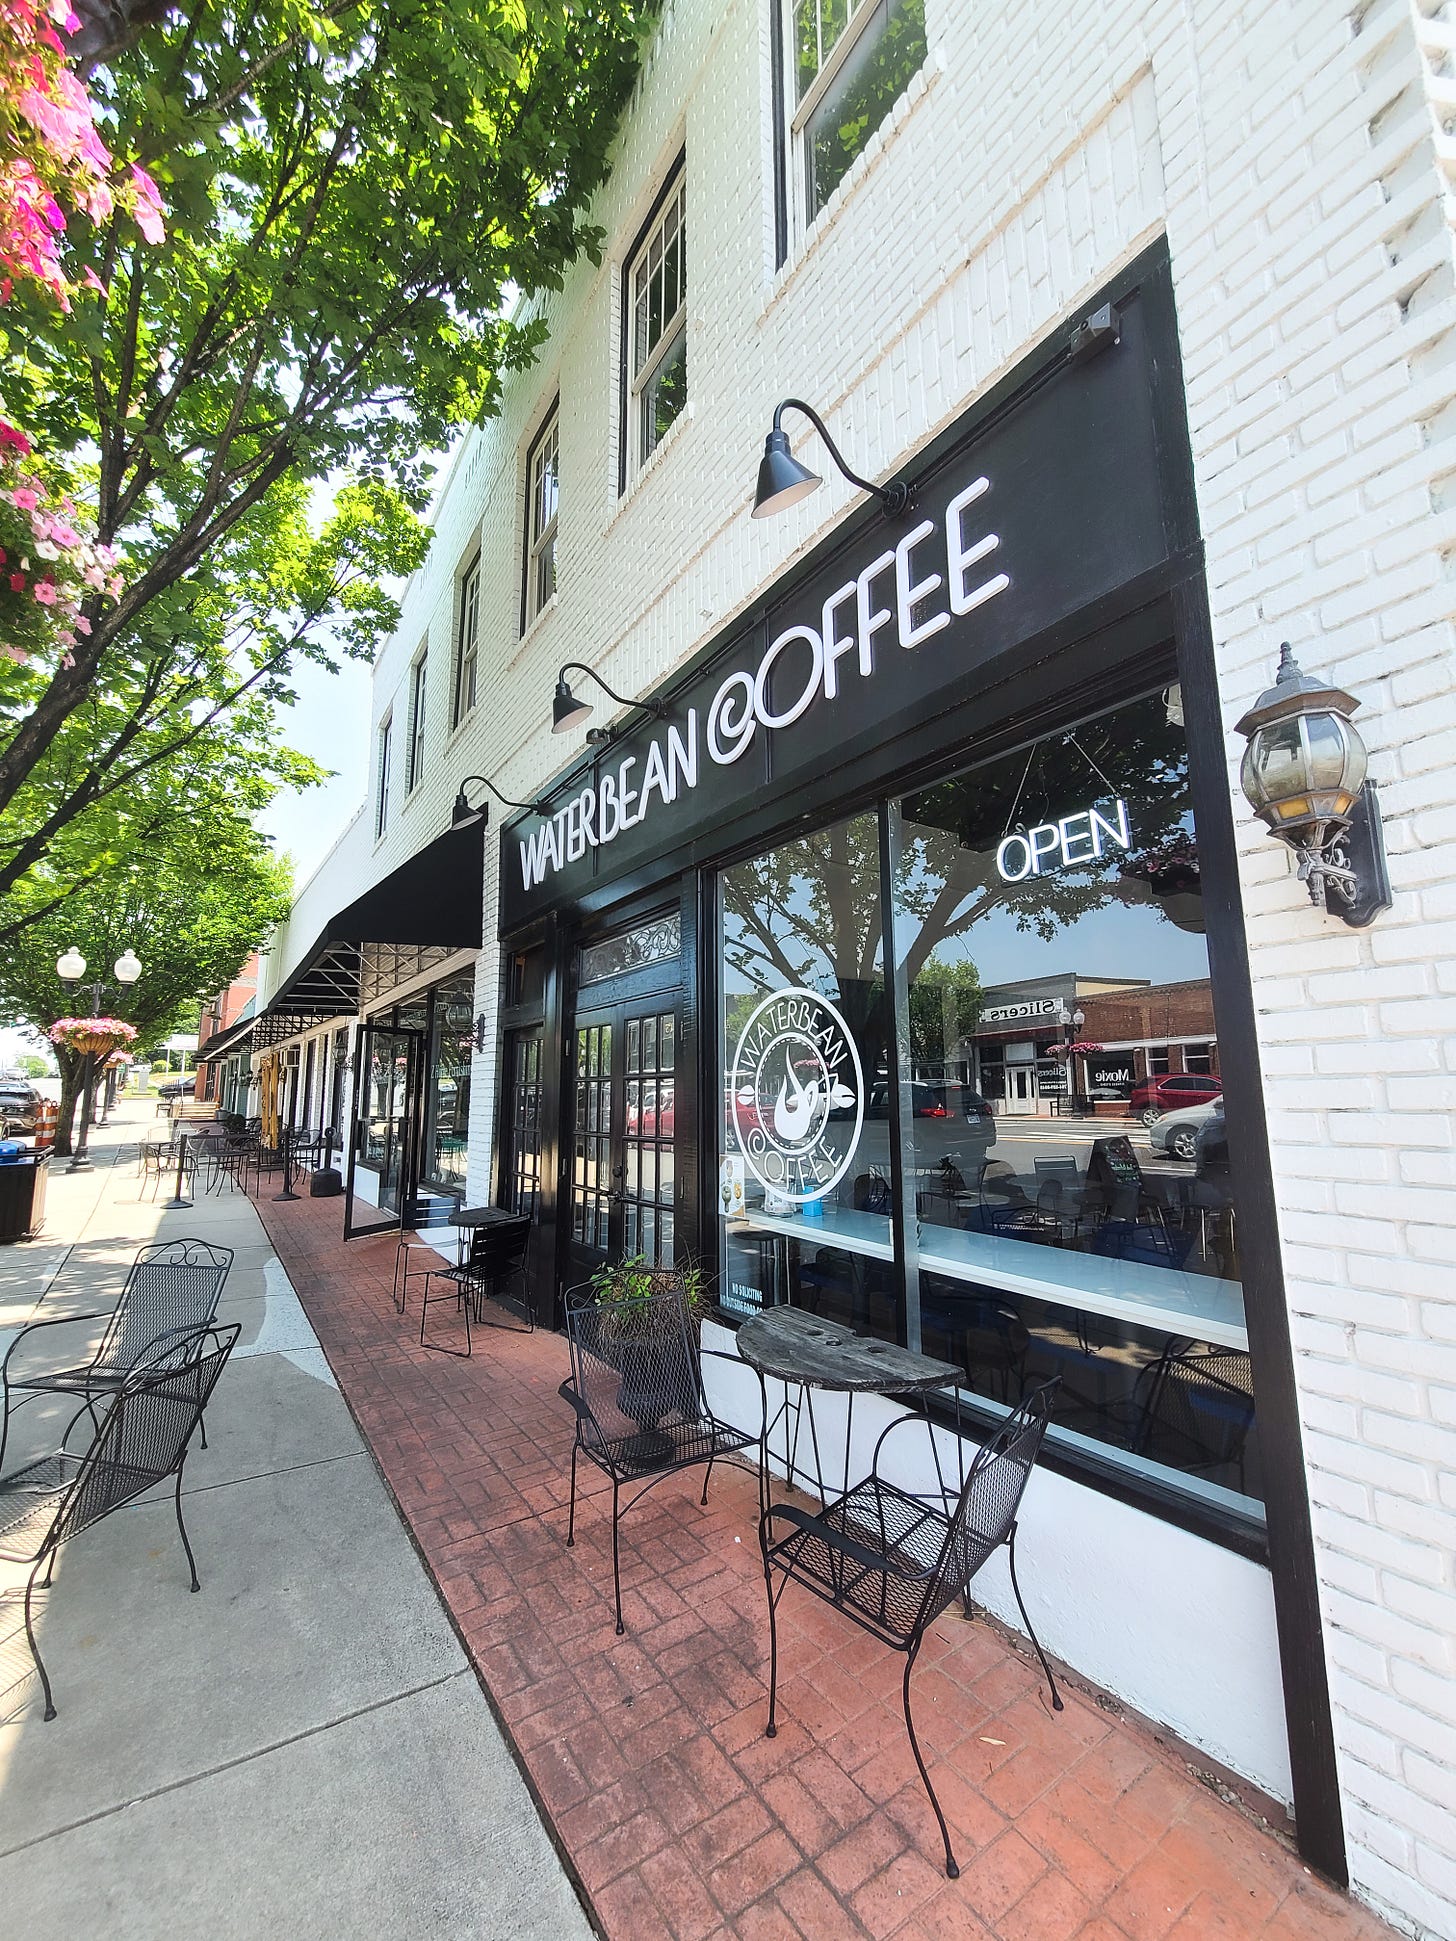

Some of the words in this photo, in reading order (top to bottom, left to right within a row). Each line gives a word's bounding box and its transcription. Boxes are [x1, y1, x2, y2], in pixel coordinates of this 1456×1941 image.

[519, 708, 697, 891] WATERBEAN
[707, 476, 1010, 765] COFFEE
[996, 800, 1131, 882] OPEN
[740, 1000, 848, 1069] WATERBEAN
[747, 1127, 843, 1191] COFFEE
